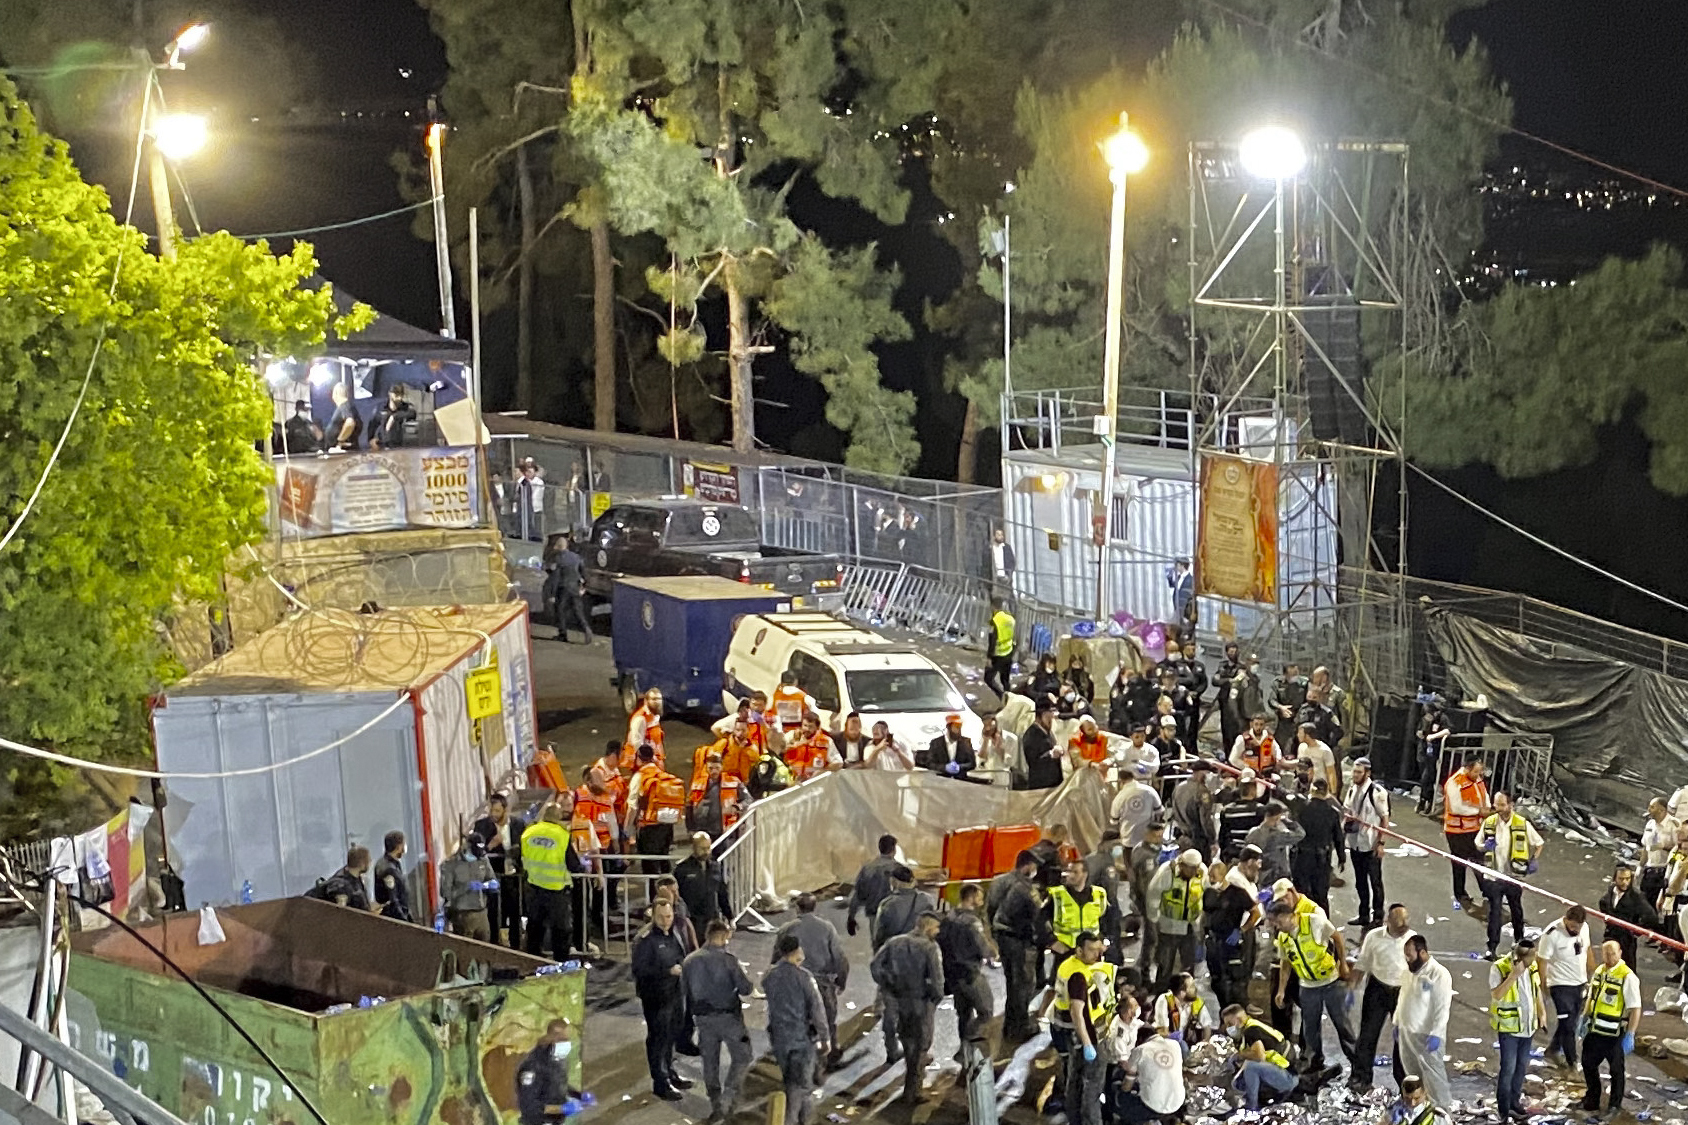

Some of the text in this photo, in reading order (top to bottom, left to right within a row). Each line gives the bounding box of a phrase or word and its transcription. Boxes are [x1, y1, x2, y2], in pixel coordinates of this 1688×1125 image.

[422, 455, 469, 471] מבצע
[426, 473, 467, 488] 1000
[425, 490, 469, 506] סיומי
[423, 508, 471, 523] הזוהר
